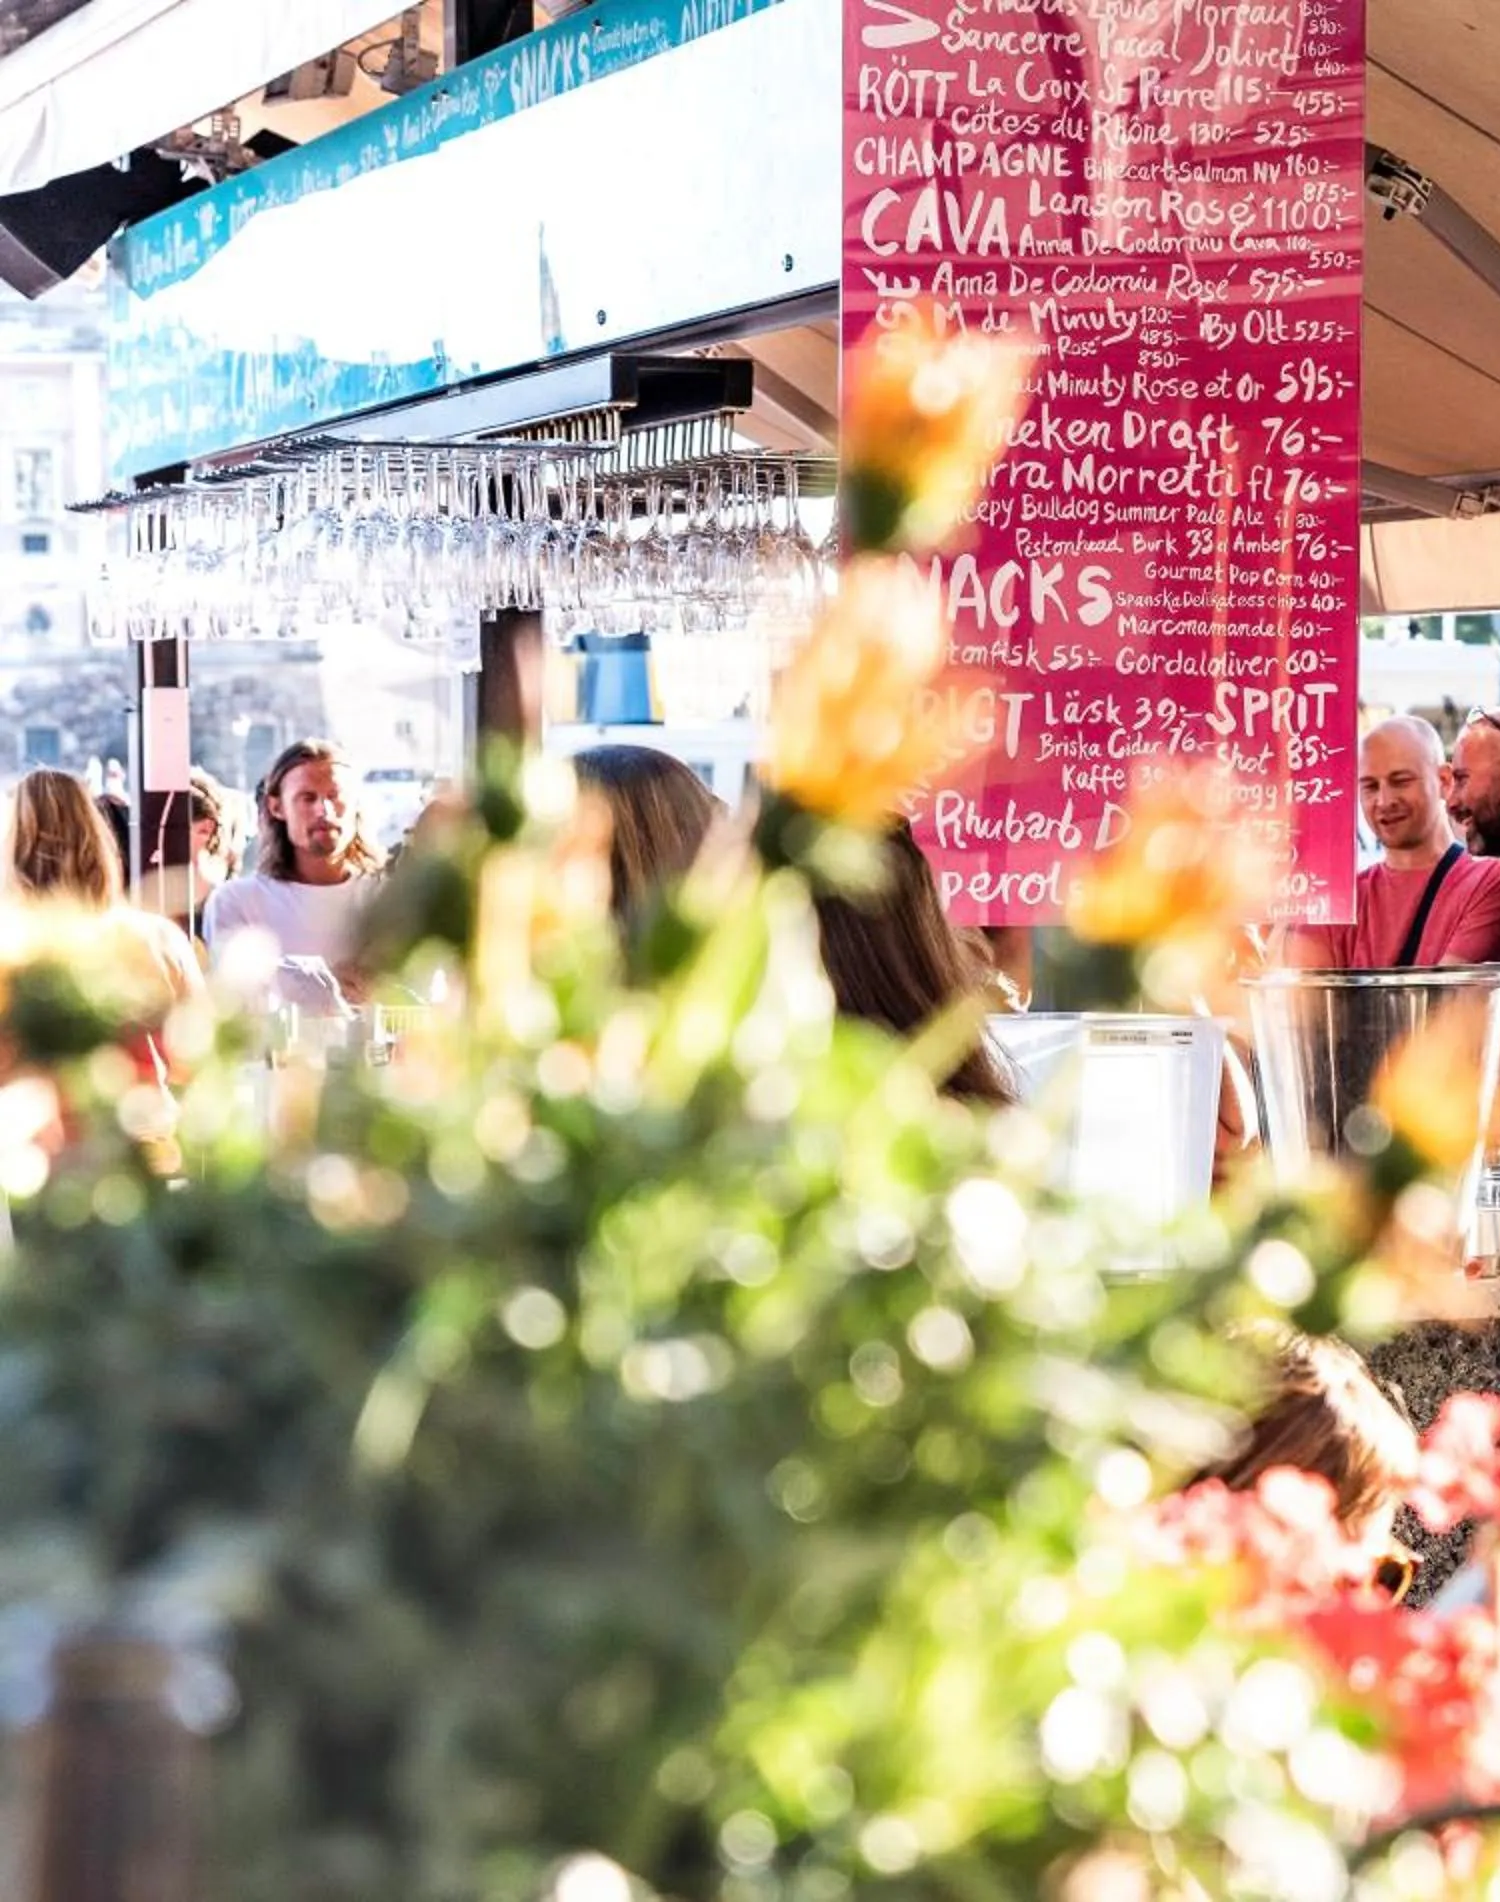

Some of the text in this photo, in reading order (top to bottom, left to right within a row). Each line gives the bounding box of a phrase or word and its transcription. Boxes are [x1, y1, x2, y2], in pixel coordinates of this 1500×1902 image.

[941, 8, 1086, 53] Sancerre
[1189, 28, 1301, 76] Jolivet
[859, 54, 958, 122] RÖTT
[967, 60, 1006, 96] La
[1015, 61, 1090, 108] Croix
[951, 100, 1041, 135] Côtes
[1091, 110, 1179, 149] Rhône
[854, 136, 1073, 177] CHAMPAGNE
[1254, 162, 1281, 184] NV
[861, 178, 1011, 258] CAVA
[1029, 179, 1156, 218] Lanson
[1161, 189, 1257, 231] Rosé
[1017, 224, 1075, 257] Anna
[1081, 227, 1110, 256] De
[1117, 226, 1223, 256] Codorniu
[1230, 222, 1281, 252] Cava
[931, 261, 998, 297] Anna
[1009, 263, 1045, 297] De
[1052, 263, 1157, 297] Codorniu
[1165, 263, 1238, 302] Rosé
[982, 302, 1018, 333] de
[1029, 297, 1138, 347] Minuty
[1244, 309, 1288, 345] Ott
[1048, 363, 1126, 407] Minuty
[1133, 371, 1199, 404] Rose
[1205, 368, 1233, 399] et
[1236, 373, 1264, 403] Or
[995, 402, 1115, 453] neken
[1123, 409, 1239, 458] Draft
[979, 460, 1054, 490] irra
[1062, 449, 1240, 494] Morretti
[1247, 465, 1274, 501] fl
[957, 498, 1015, 531] eepy
[1021, 493, 1099, 525] Bulldog
[1103, 501, 1182, 525] Summer
[1185, 500, 1229, 526] Pale
[1231, 503, 1264, 527] Ale
[1015, 528, 1125, 557] Pistonhead
[1132, 530, 1178, 557] Burk
[1186, 528, 1213, 560] 33
[1233, 530, 1293, 554] Amber
[898, 551, 1113, 630] NACKS
[1144, 560, 1224, 583] Gourmet
[1229, 563, 1259, 587] Pop
[1263, 567, 1304, 588] Corn
[1115, 588, 1183, 613] Spanska
[1267, 592, 1307, 613] chips
[915, 686, 1035, 759] RIGT
[1044, 689, 1123, 726] Läsk
[1205, 682, 1338, 737] SPRIT
[1034, 731, 1101, 762] Briska
[1107, 728, 1163, 759] Cider
[1216, 740, 1275, 775] Shot
[1062, 764, 1126, 794] Kaffe
[935, 789, 1082, 849] Rhubarb
[941, 861, 1065, 912] perol
